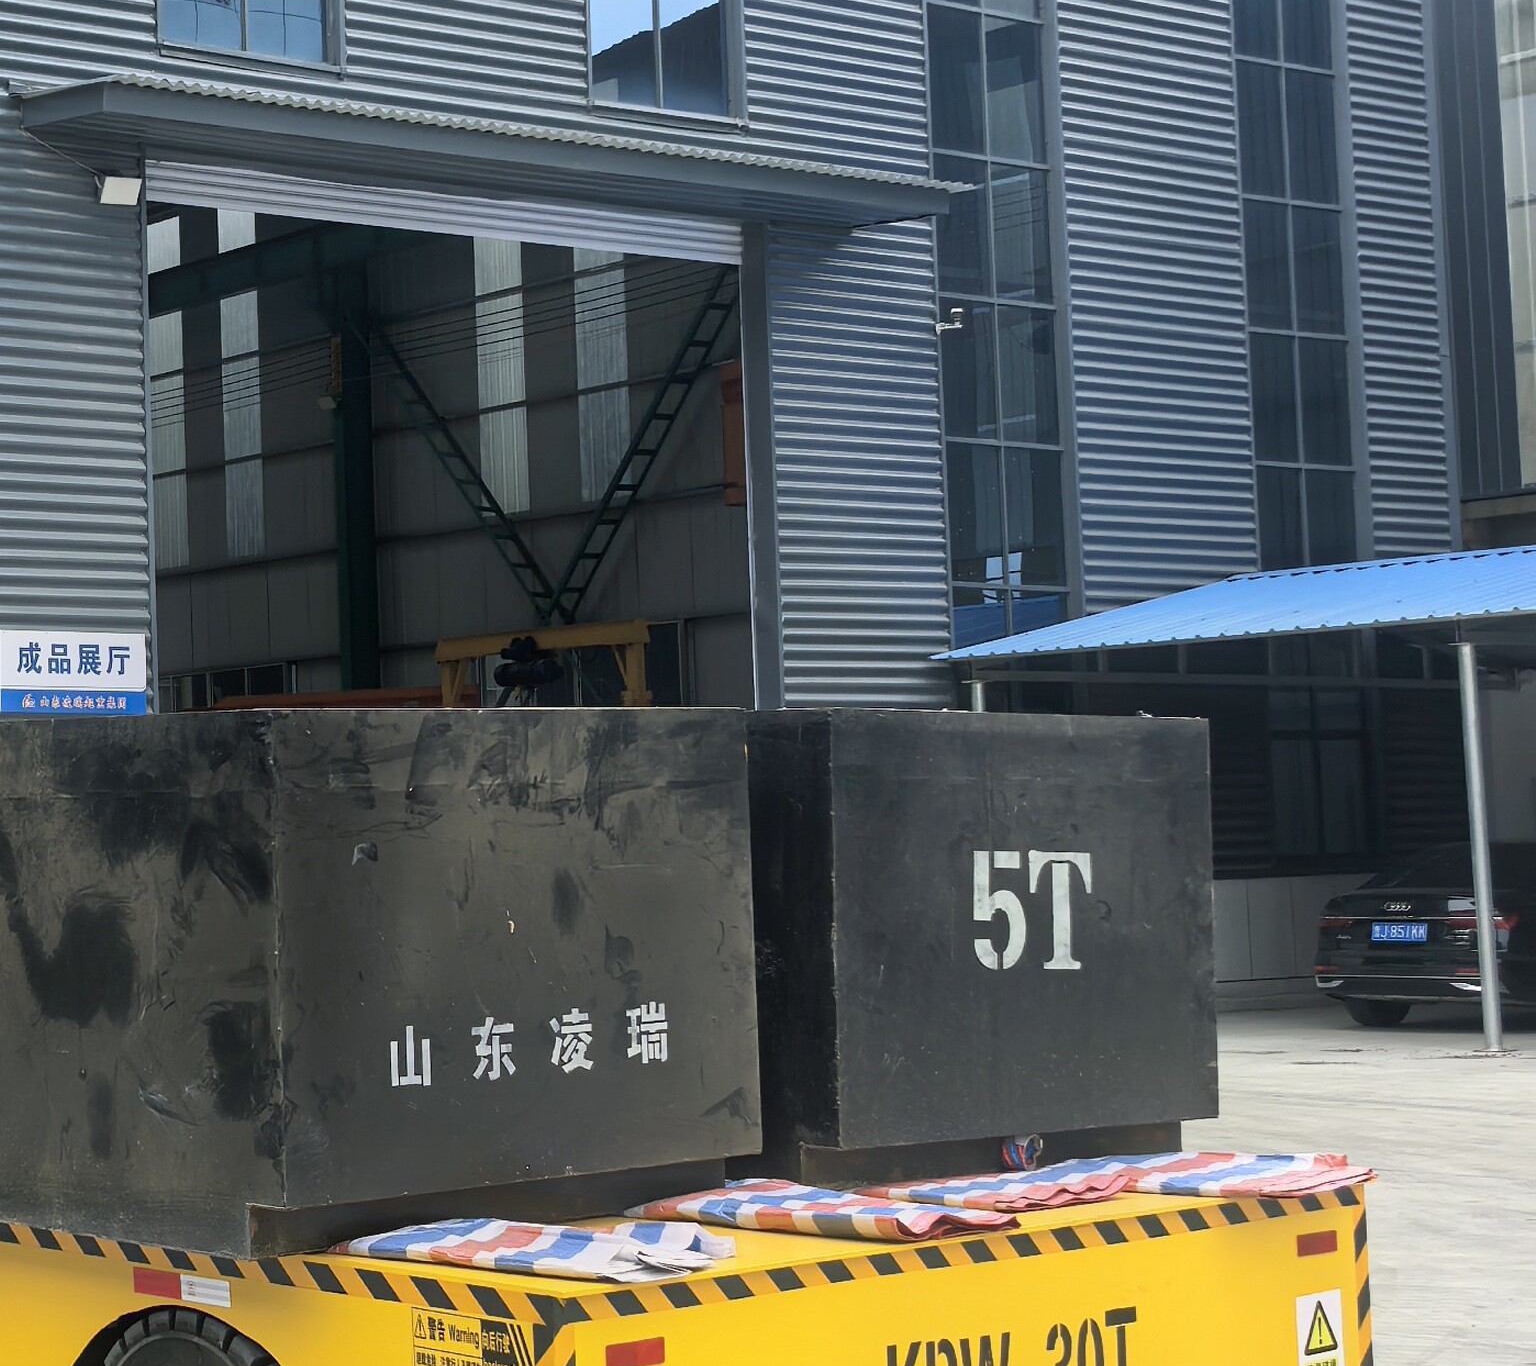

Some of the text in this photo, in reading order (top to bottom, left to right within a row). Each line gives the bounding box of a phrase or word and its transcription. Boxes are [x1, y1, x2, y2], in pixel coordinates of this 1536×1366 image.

[17, 642, 130, 676] 成品展厅
[973, 850, 1093, 970] 5T
[390, 1001, 668, 1088] 山东凌瑞
[448, 1323, 480, 1350] Warning
